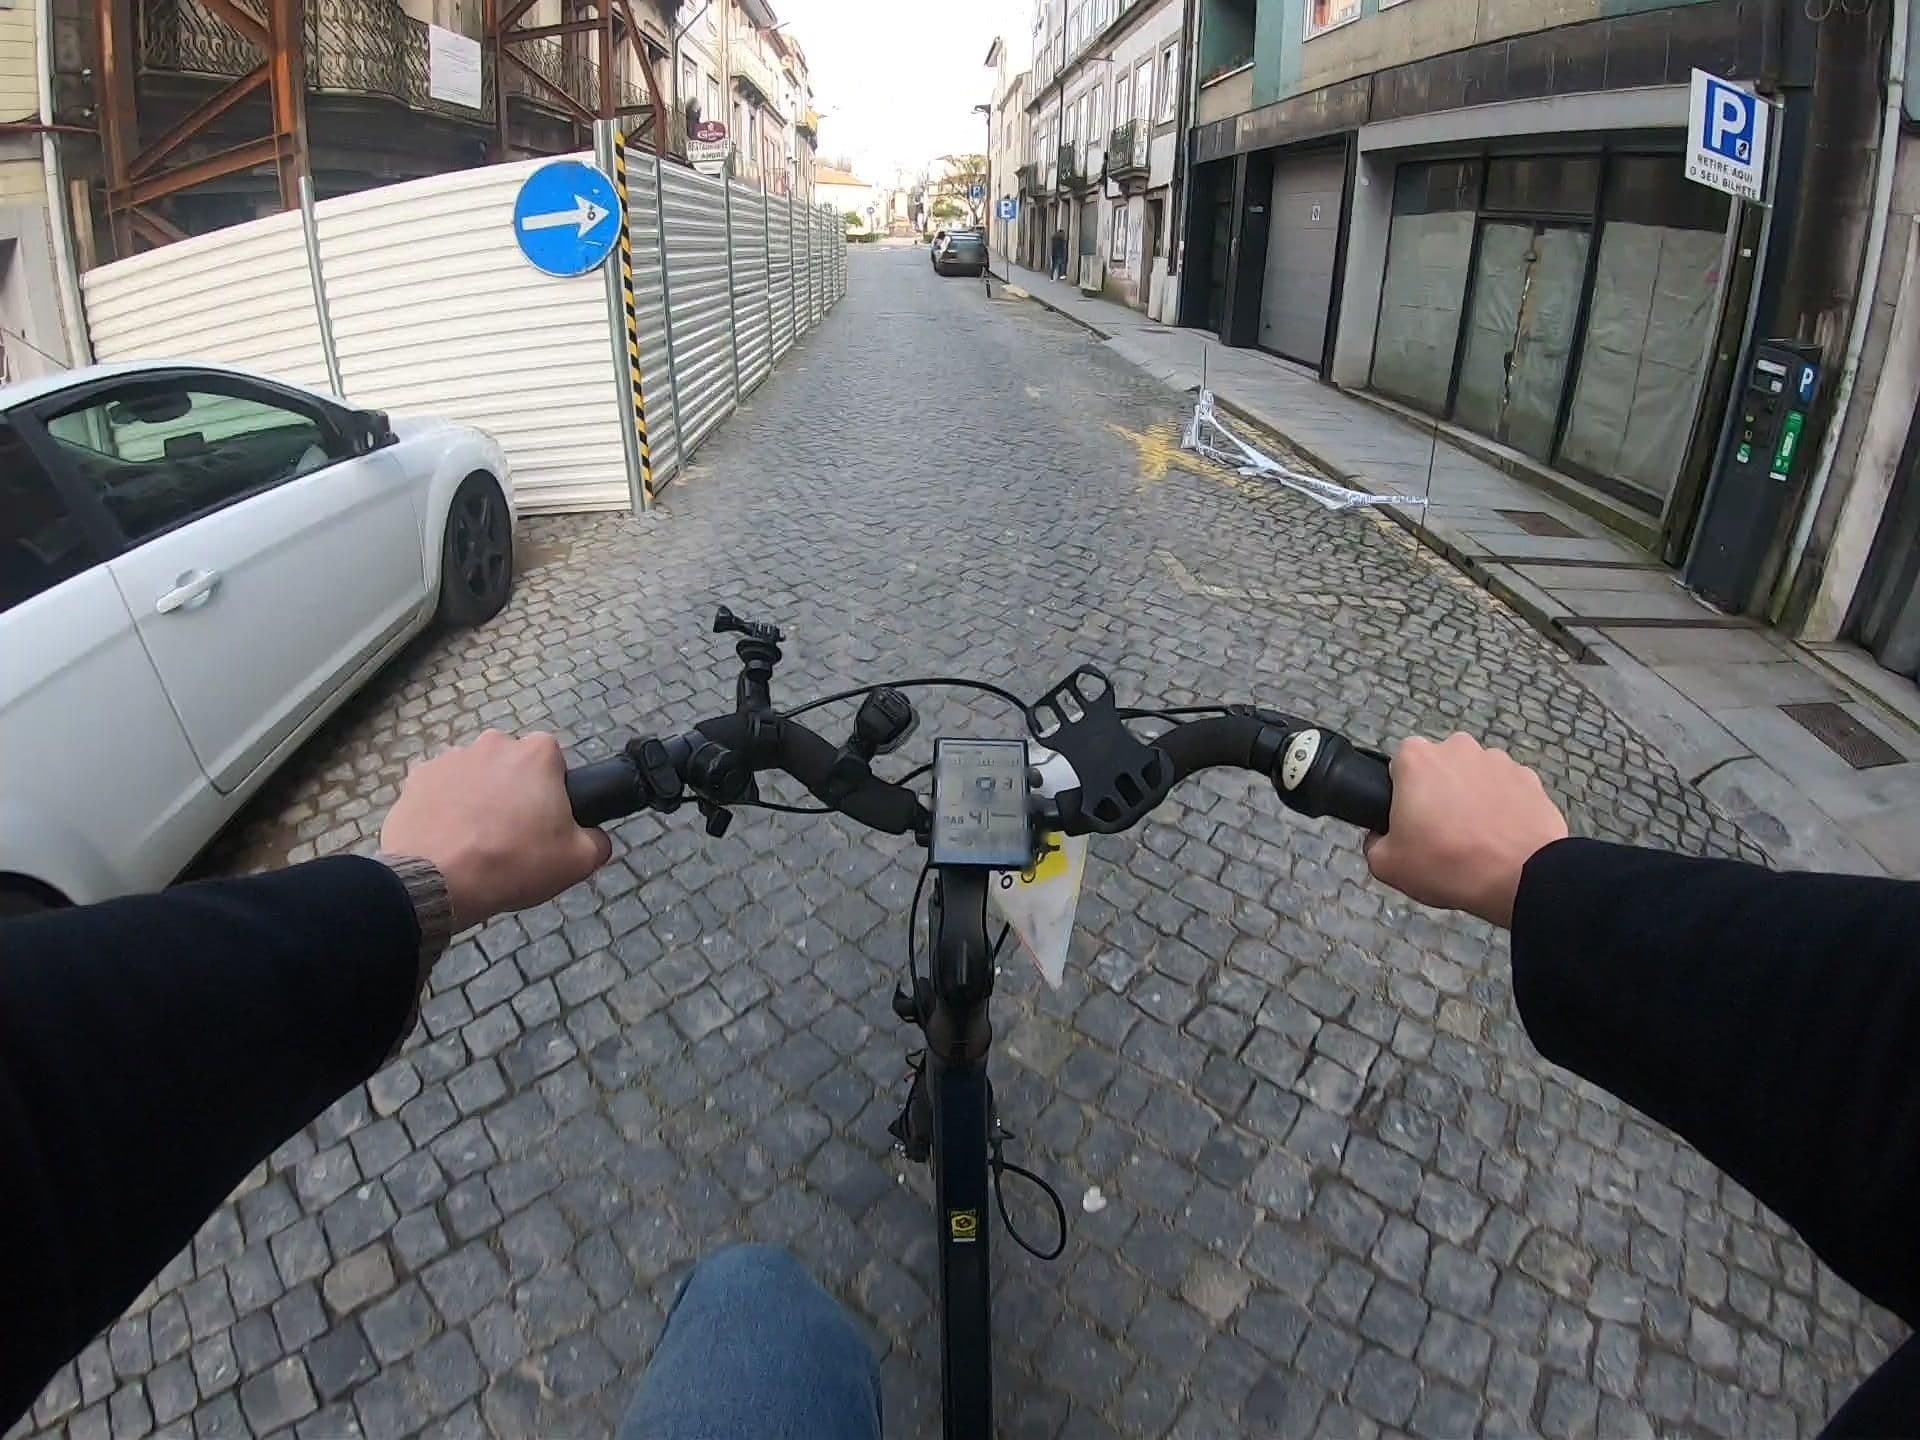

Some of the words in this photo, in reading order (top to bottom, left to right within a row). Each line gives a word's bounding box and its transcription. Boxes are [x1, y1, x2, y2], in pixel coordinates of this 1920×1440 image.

[1711, 87, 1747, 150] P
[1689, 166, 1697, 176] O
[1700, 170, 1719, 185] SEU
[1722, 178, 1757, 200] BILHETE
[1697, 153, 1729, 174] RETIRE
[1731, 167, 1754, 184] AQUI
[1799, 367, 1814, 393] P
